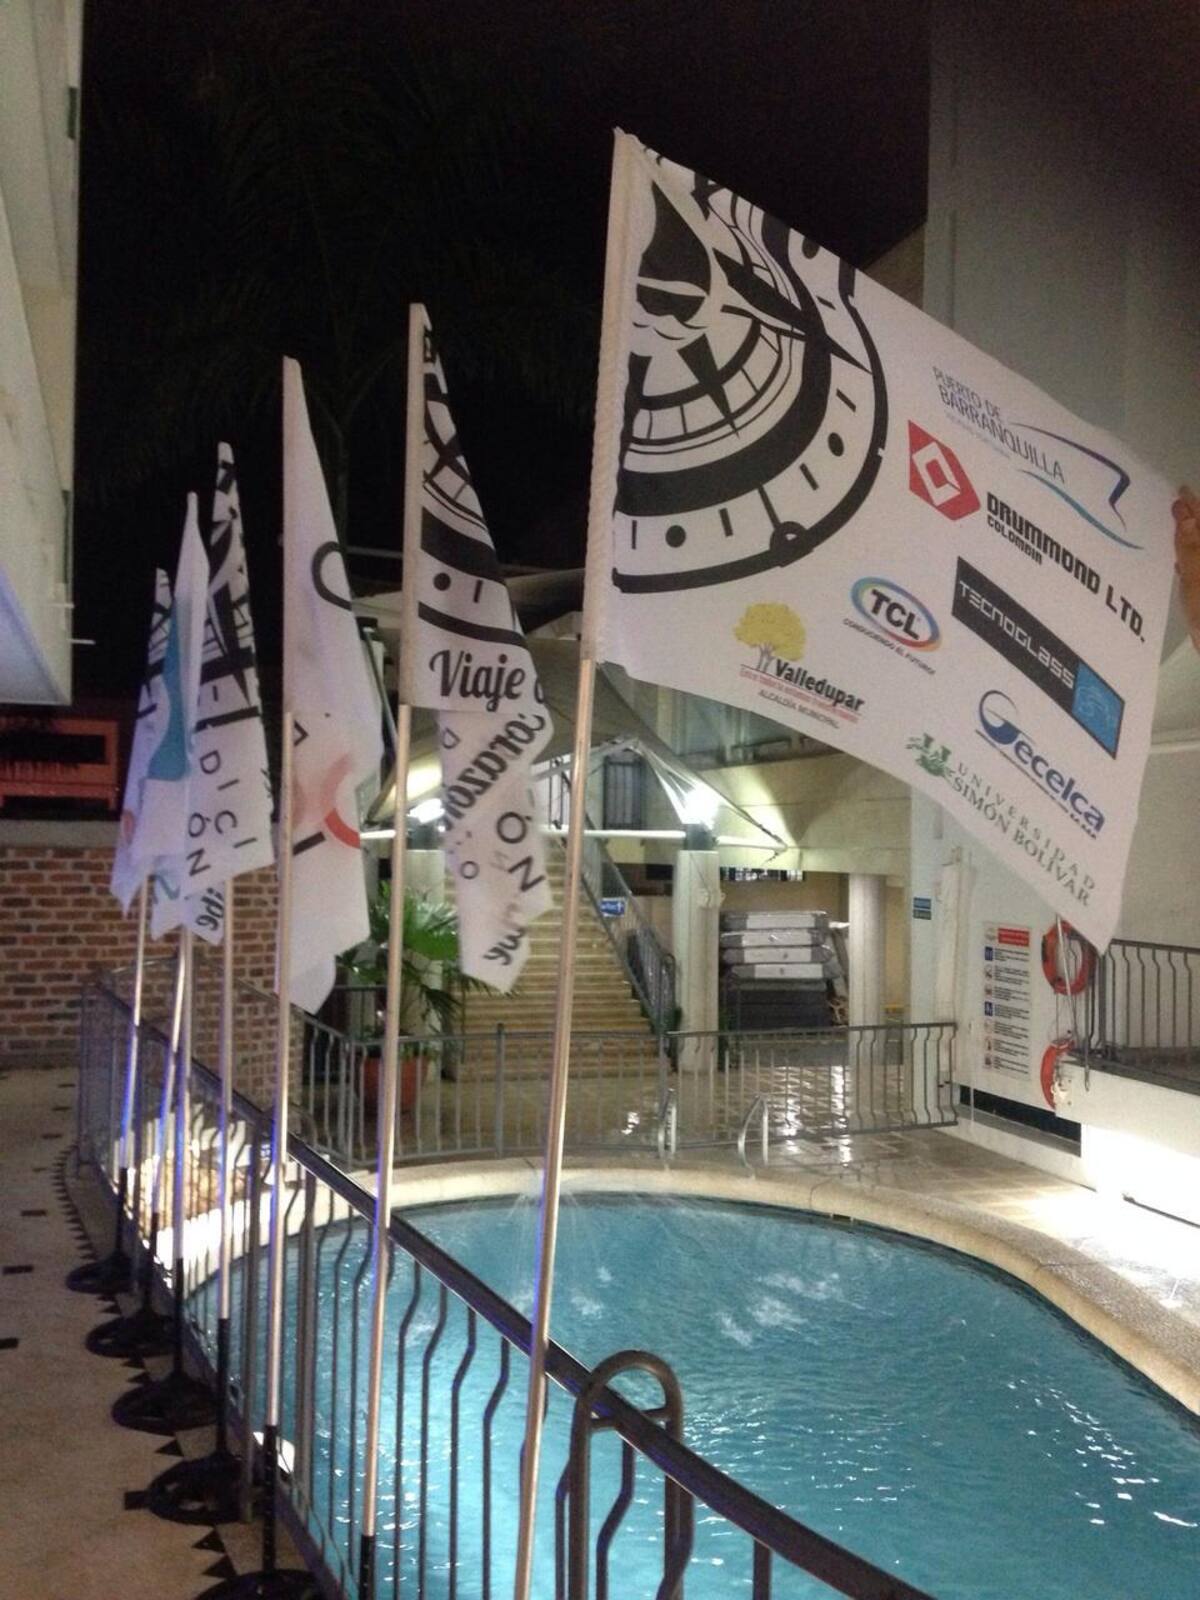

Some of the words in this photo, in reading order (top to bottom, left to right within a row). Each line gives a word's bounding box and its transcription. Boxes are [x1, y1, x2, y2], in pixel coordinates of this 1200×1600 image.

[933, 366, 981, 408] PUERTO
[985, 399, 1003, 419] DE
[939, 384, 1065, 484] BARRANQUILLA
[987, 515, 1043, 565] COLOMBIA
[987, 491, 1101, 595] DRUMMOND
[1105, 584, 1145, 643] LTD.
[870, 588, 920, 640] TCL
[429, 650, 526, 712] Viaje
[775, 659, 865, 712] Valledupar
[957, 762, 1096, 890] UNIVERSIDAD
